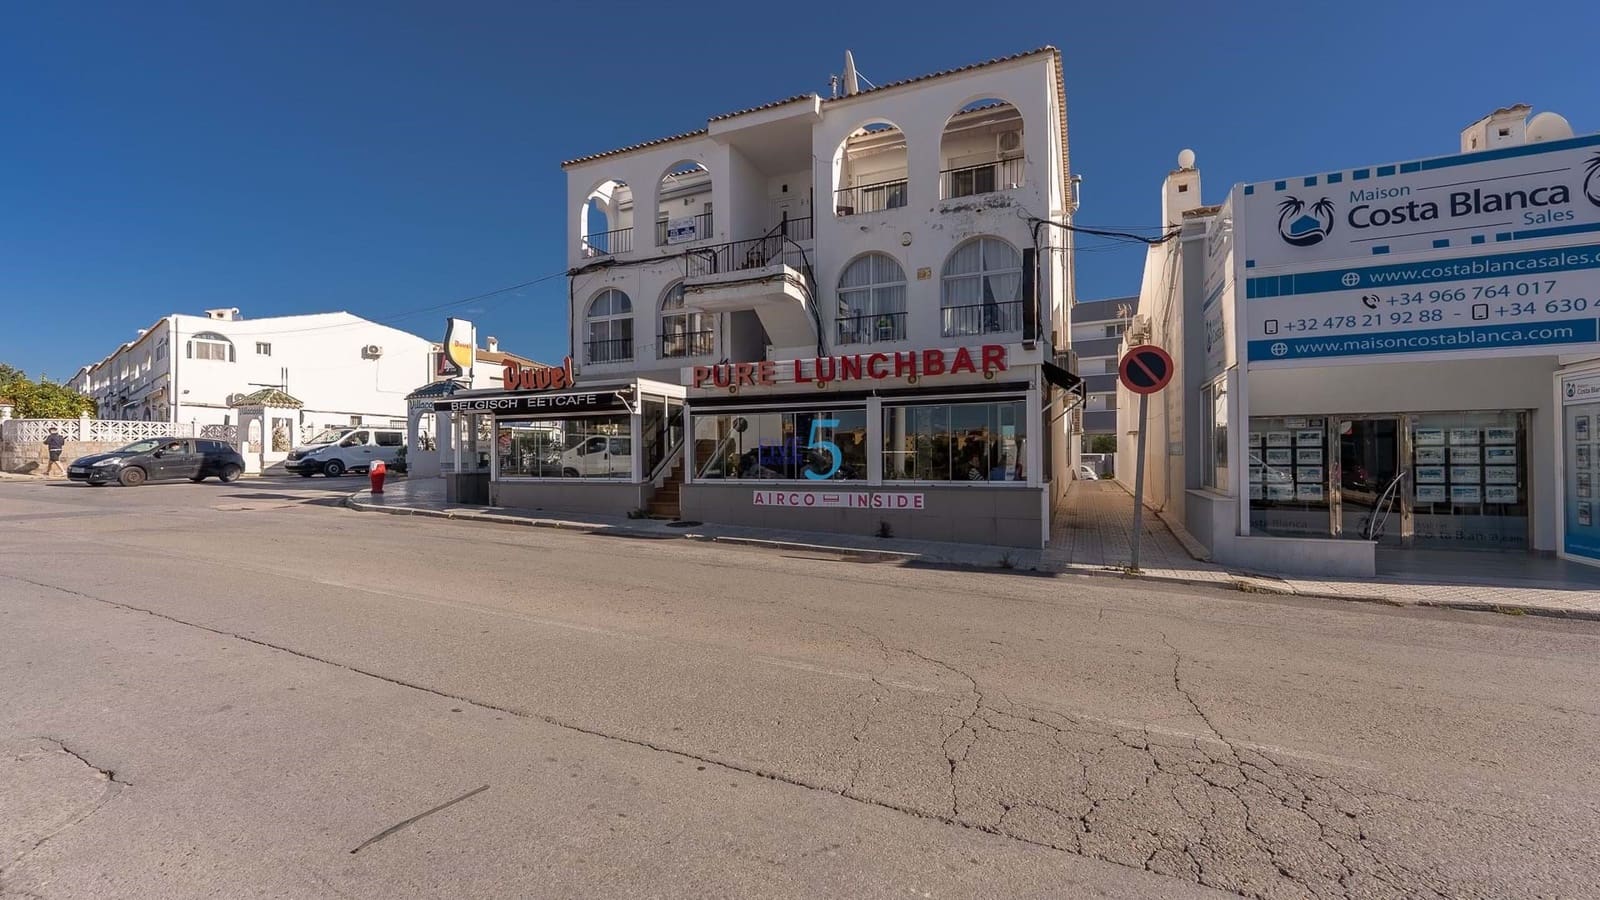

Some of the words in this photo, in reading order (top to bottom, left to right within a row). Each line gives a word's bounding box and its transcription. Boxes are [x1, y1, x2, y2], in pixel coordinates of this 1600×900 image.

[1348, 199, 1439, 229] Costa
[1450, 184, 1570, 217] Blanca
[1350, 185, 1410, 203] Maison
[1523, 208, 1574, 225] Sales
[1386, 291, 1424, 306] +34
[1429, 288, 1466, 303] 966
[1472, 284, 1510, 299] 764
[1516, 280, 1557, 296] 017
[1284, 318, 1318, 332] +32
[1323, 315, 1356, 329] 478
[1362, 313, 1382, 327] 21
[1390, 312, 1413, 325] 92
[1419, 308, 1443, 323] 88
[1495, 302, 1537, 318] +34
[1545, 298, 1588, 314] 630
[1295, 326, 1573, 353] www.maisoncostablanca.com
[501, 355, 576, 391] Duvel
[692, 361, 776, 389] PURE
[793, 344, 1009, 385] LUNCHBAR
[450, 398, 518, 411] BELGISCH
[527, 393, 597, 408] EETCAFE
[754, 492, 816, 506] AIRCO
[848, 493, 924, 509] INSIDE
